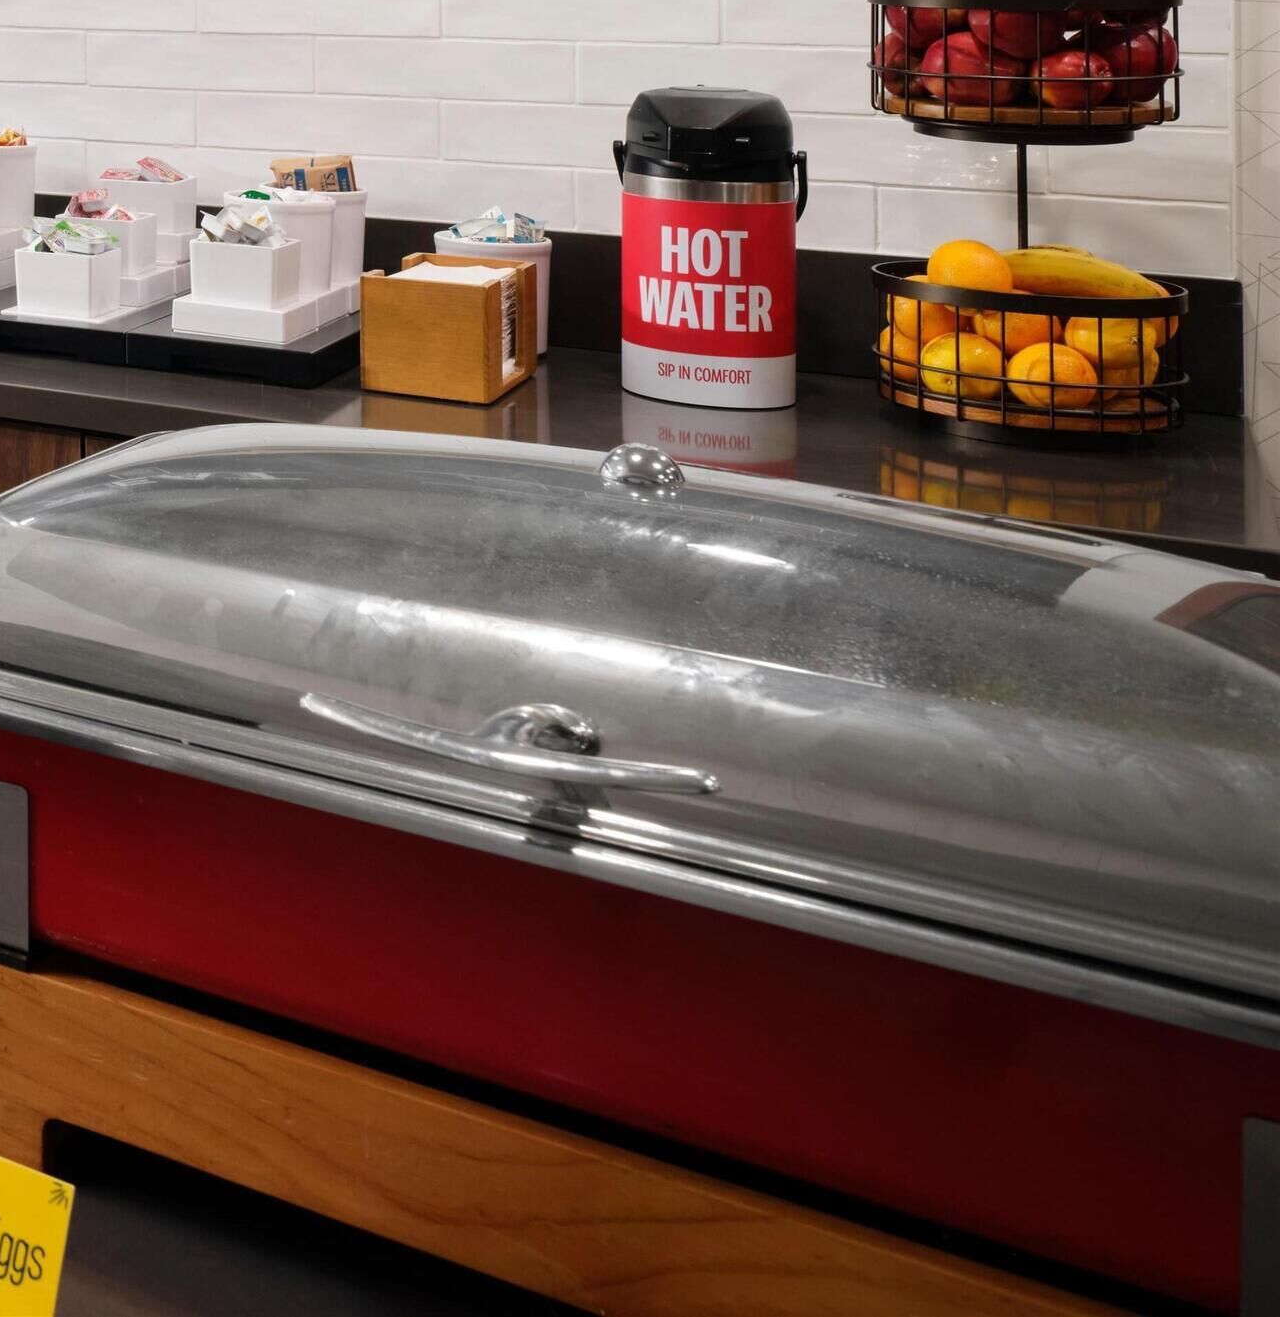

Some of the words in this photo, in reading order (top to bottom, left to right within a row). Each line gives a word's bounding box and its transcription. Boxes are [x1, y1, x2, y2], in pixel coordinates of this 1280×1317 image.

[661, 225, 749, 278] HOT
[639, 275, 773, 333] WATER
[657, 362, 675, 378] SIP
[678, 365, 691, 380] IN
[694, 366, 752, 384] COMFORT
